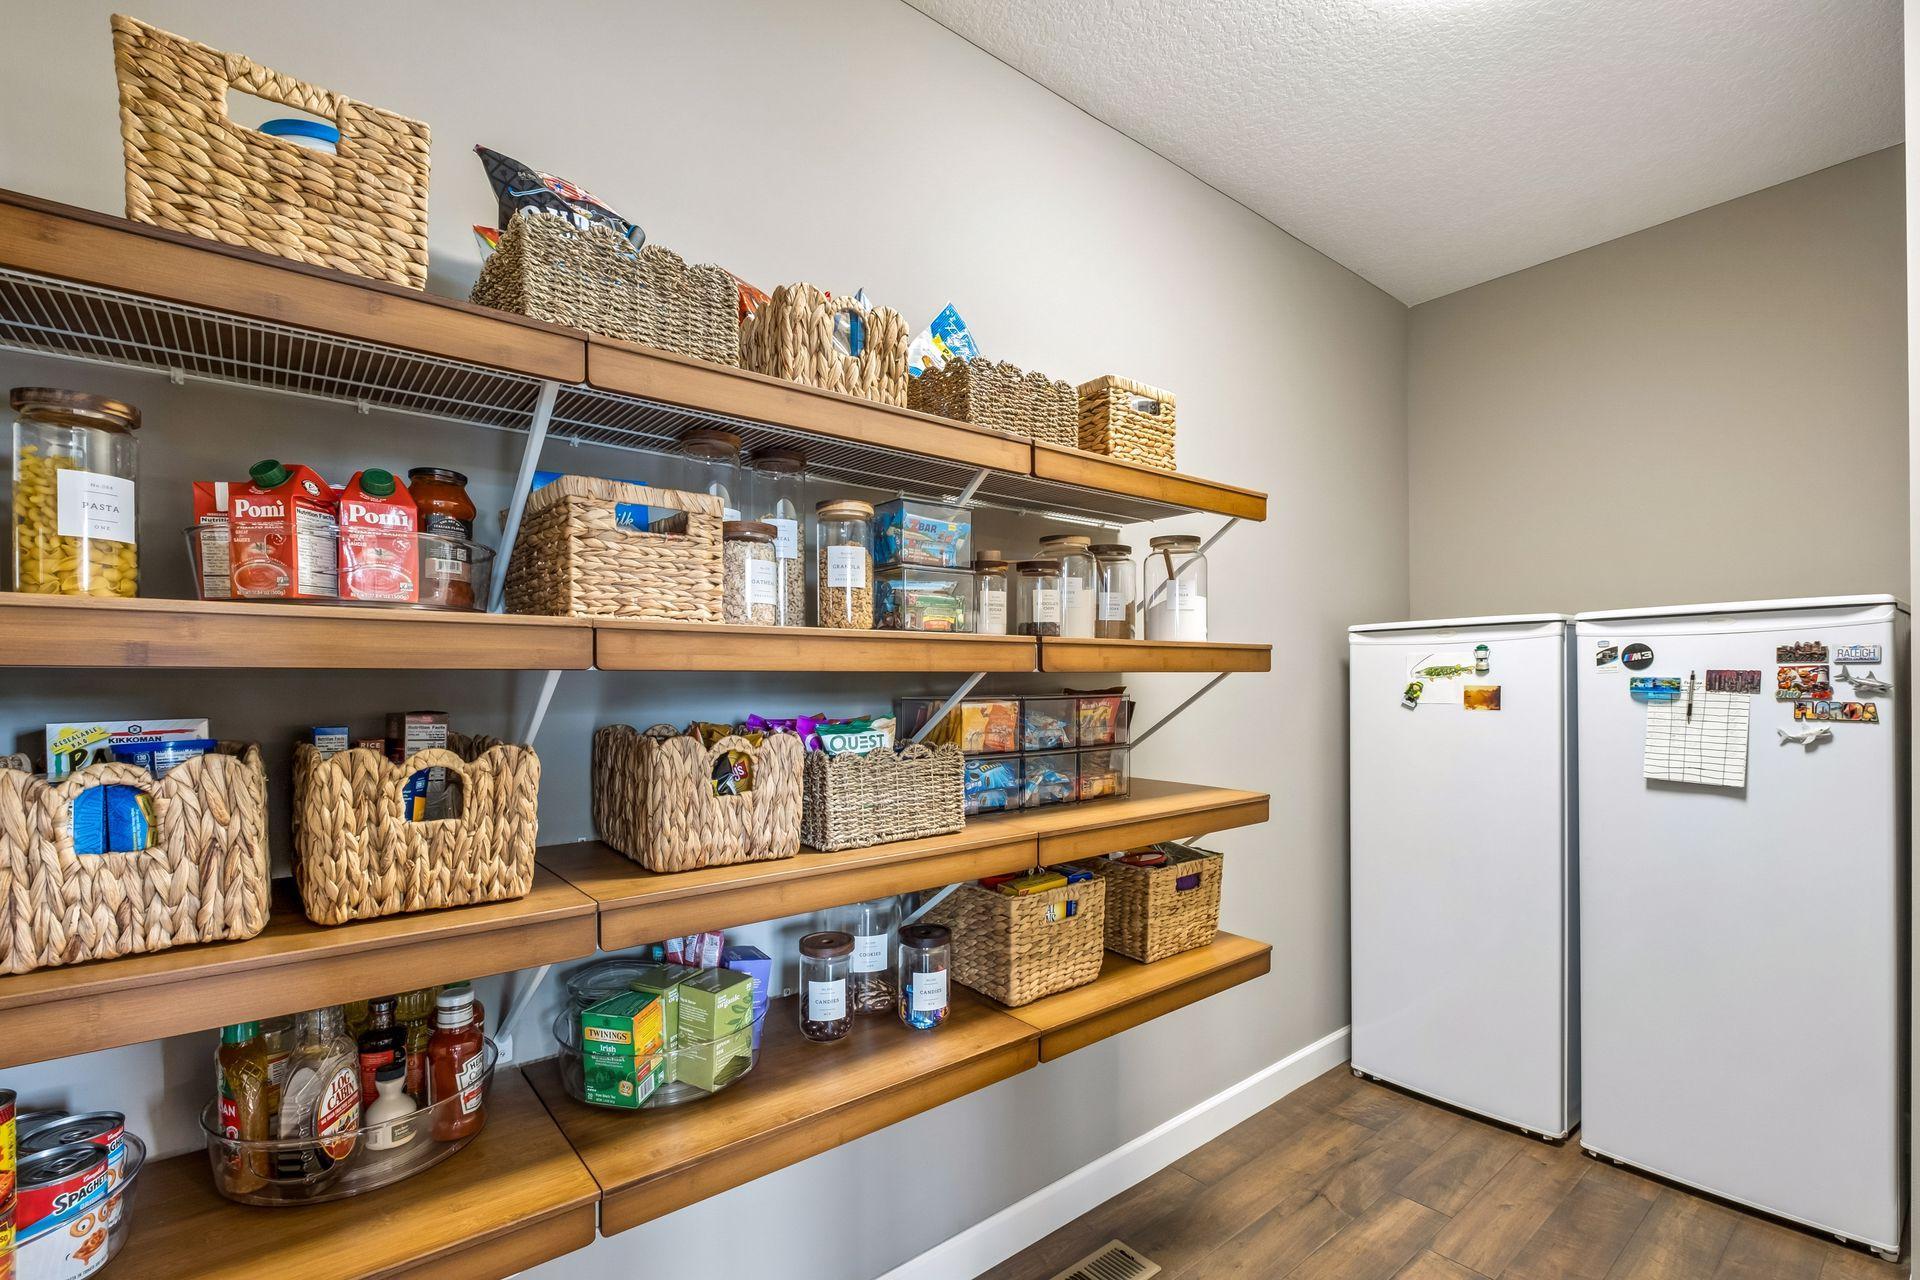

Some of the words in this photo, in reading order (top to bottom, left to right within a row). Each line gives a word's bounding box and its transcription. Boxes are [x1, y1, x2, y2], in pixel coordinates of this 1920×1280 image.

[82, 501, 120, 513] PASTA
[616, 511, 634, 526] ilk
[1837, 648, 1876, 657] RALEIGH
[1794, 701, 1879, 721] FLORIDA
[53, 727, 98, 748] RESEALABLE
[71, 738, 88, 749] BAG
[108, 736, 162, 744] KIKKOMAN
[829, 733, 885, 752] QUEST
[589, 1029, 627, 1041] TWININGS
[600, 1044, 617, 1053] Irish
[332, 1071, 351, 1093] LOG
[327, 1083, 356, 1111] CABIN
